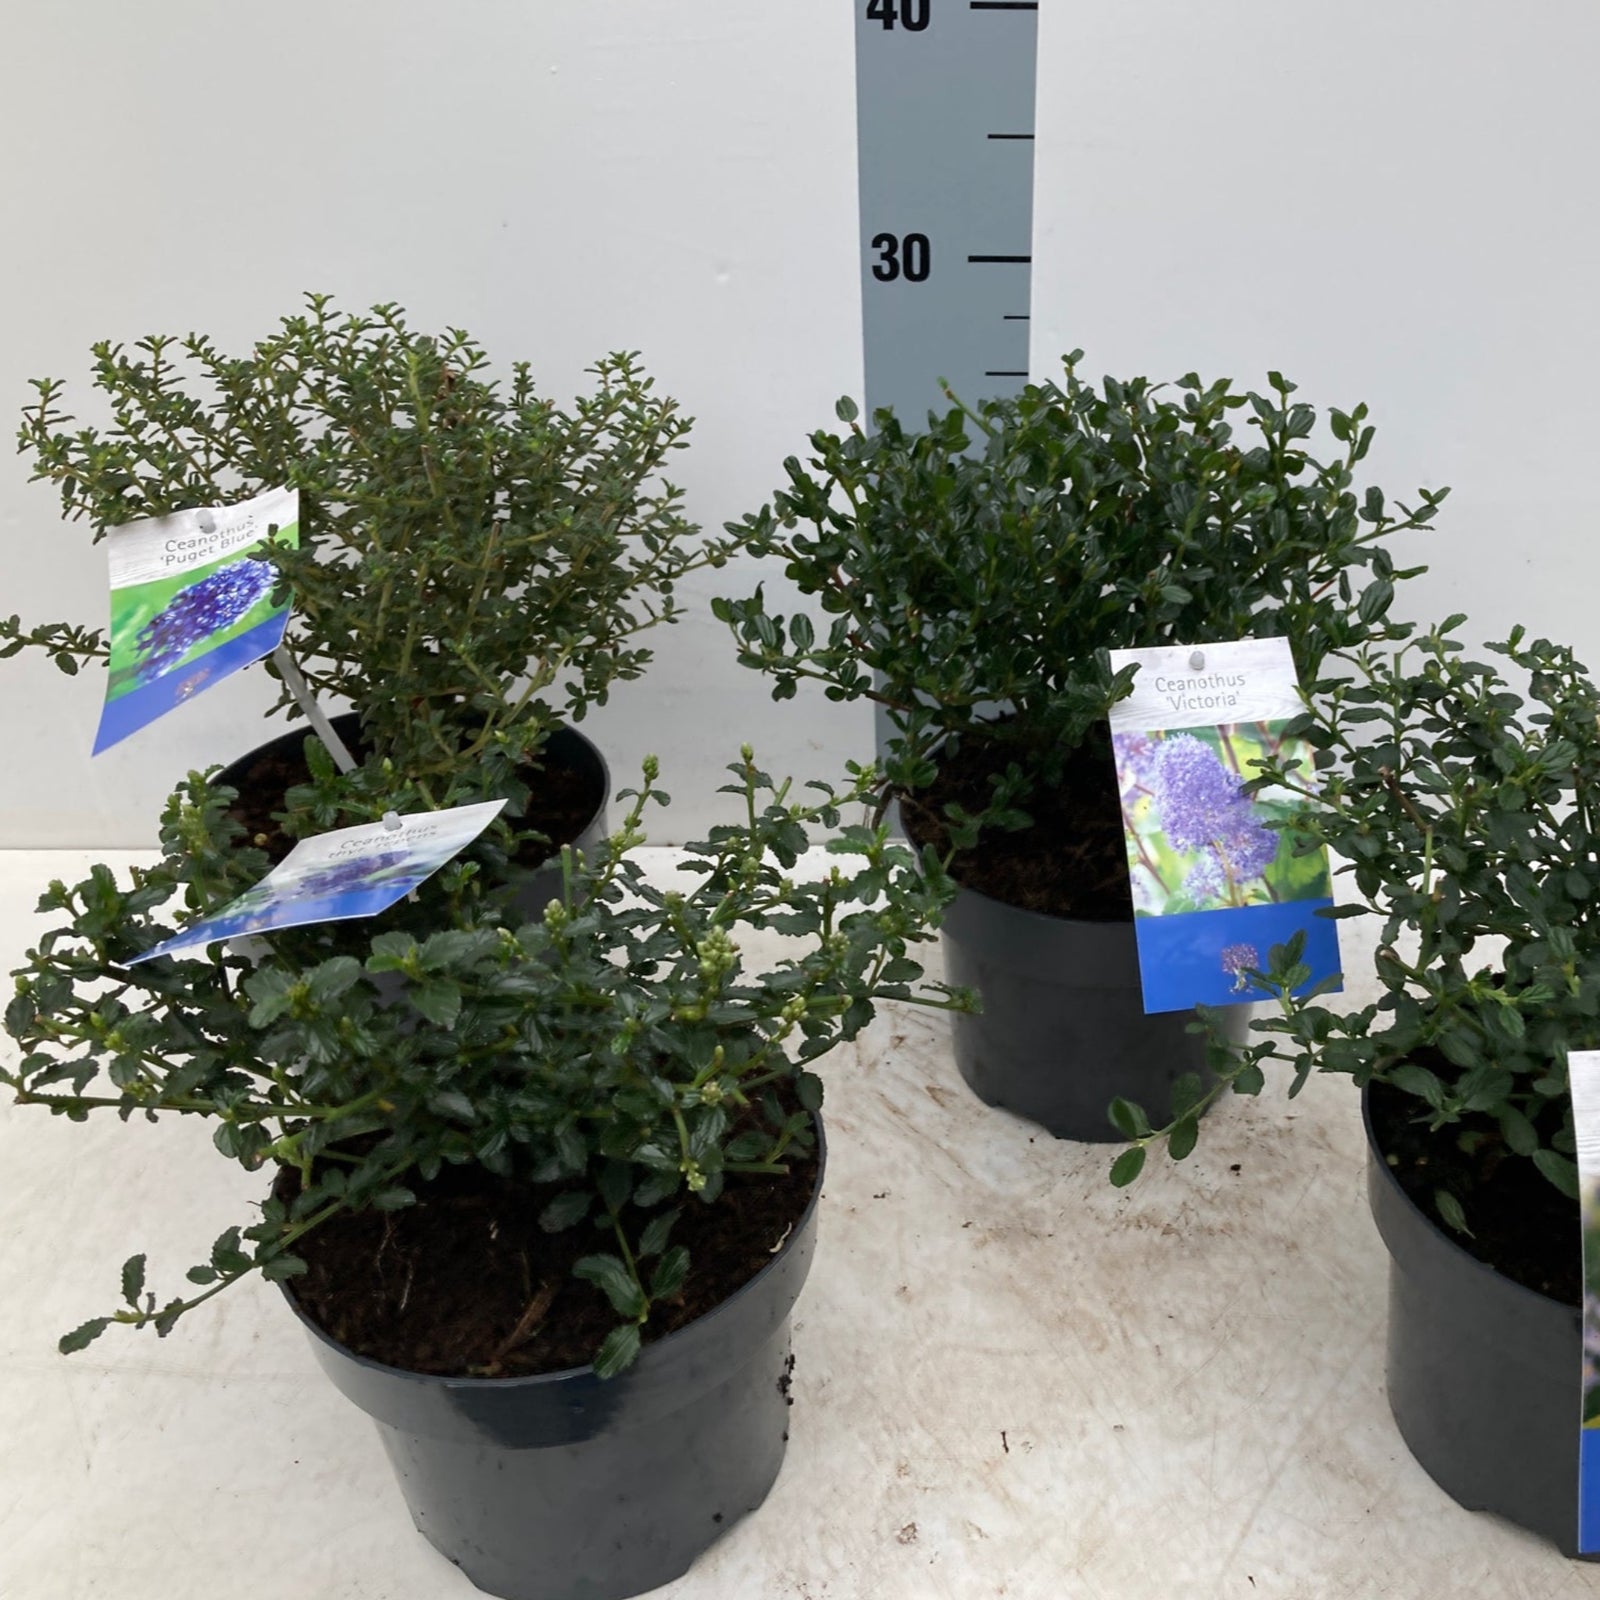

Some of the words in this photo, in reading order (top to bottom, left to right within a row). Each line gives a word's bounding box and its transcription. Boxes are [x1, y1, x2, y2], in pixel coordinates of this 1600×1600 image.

[866, 0, 930, 31] 40
[871, 233, 930, 282] 30
[165, 519, 254, 553] Ceanothus
[160, 545, 214, 566] 'Puget
[1155, 673, 1246, 693] Ceanothus
[1166, 691, 1241, 711] 'Victoria'
